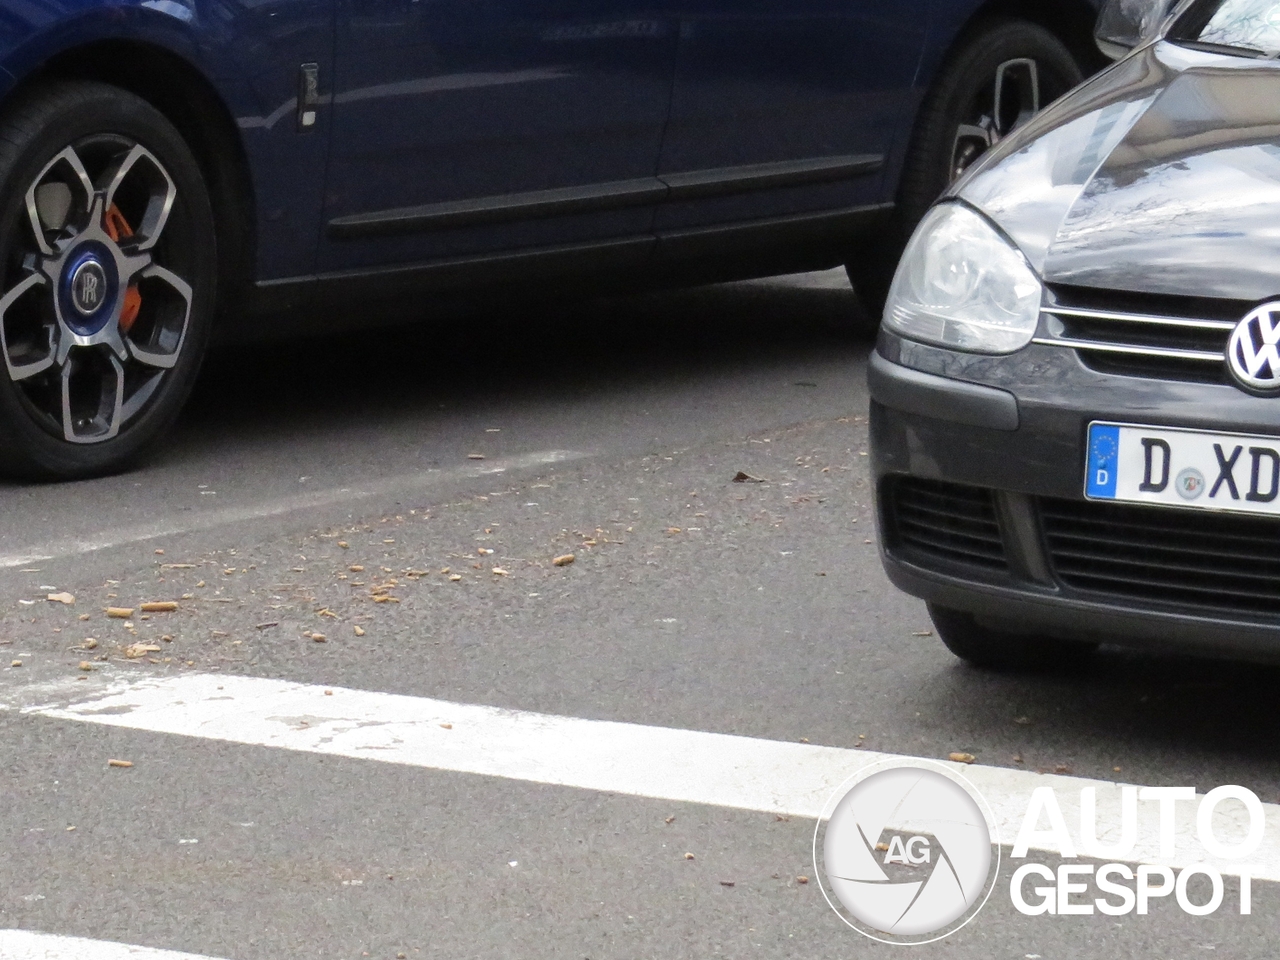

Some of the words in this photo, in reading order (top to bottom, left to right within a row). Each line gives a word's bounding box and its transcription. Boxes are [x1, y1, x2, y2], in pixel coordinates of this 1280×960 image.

[1096, 470, 1108, 485] D
[1139, 437, 1171, 493] D
[1208, 443, 1280, 503] XD
